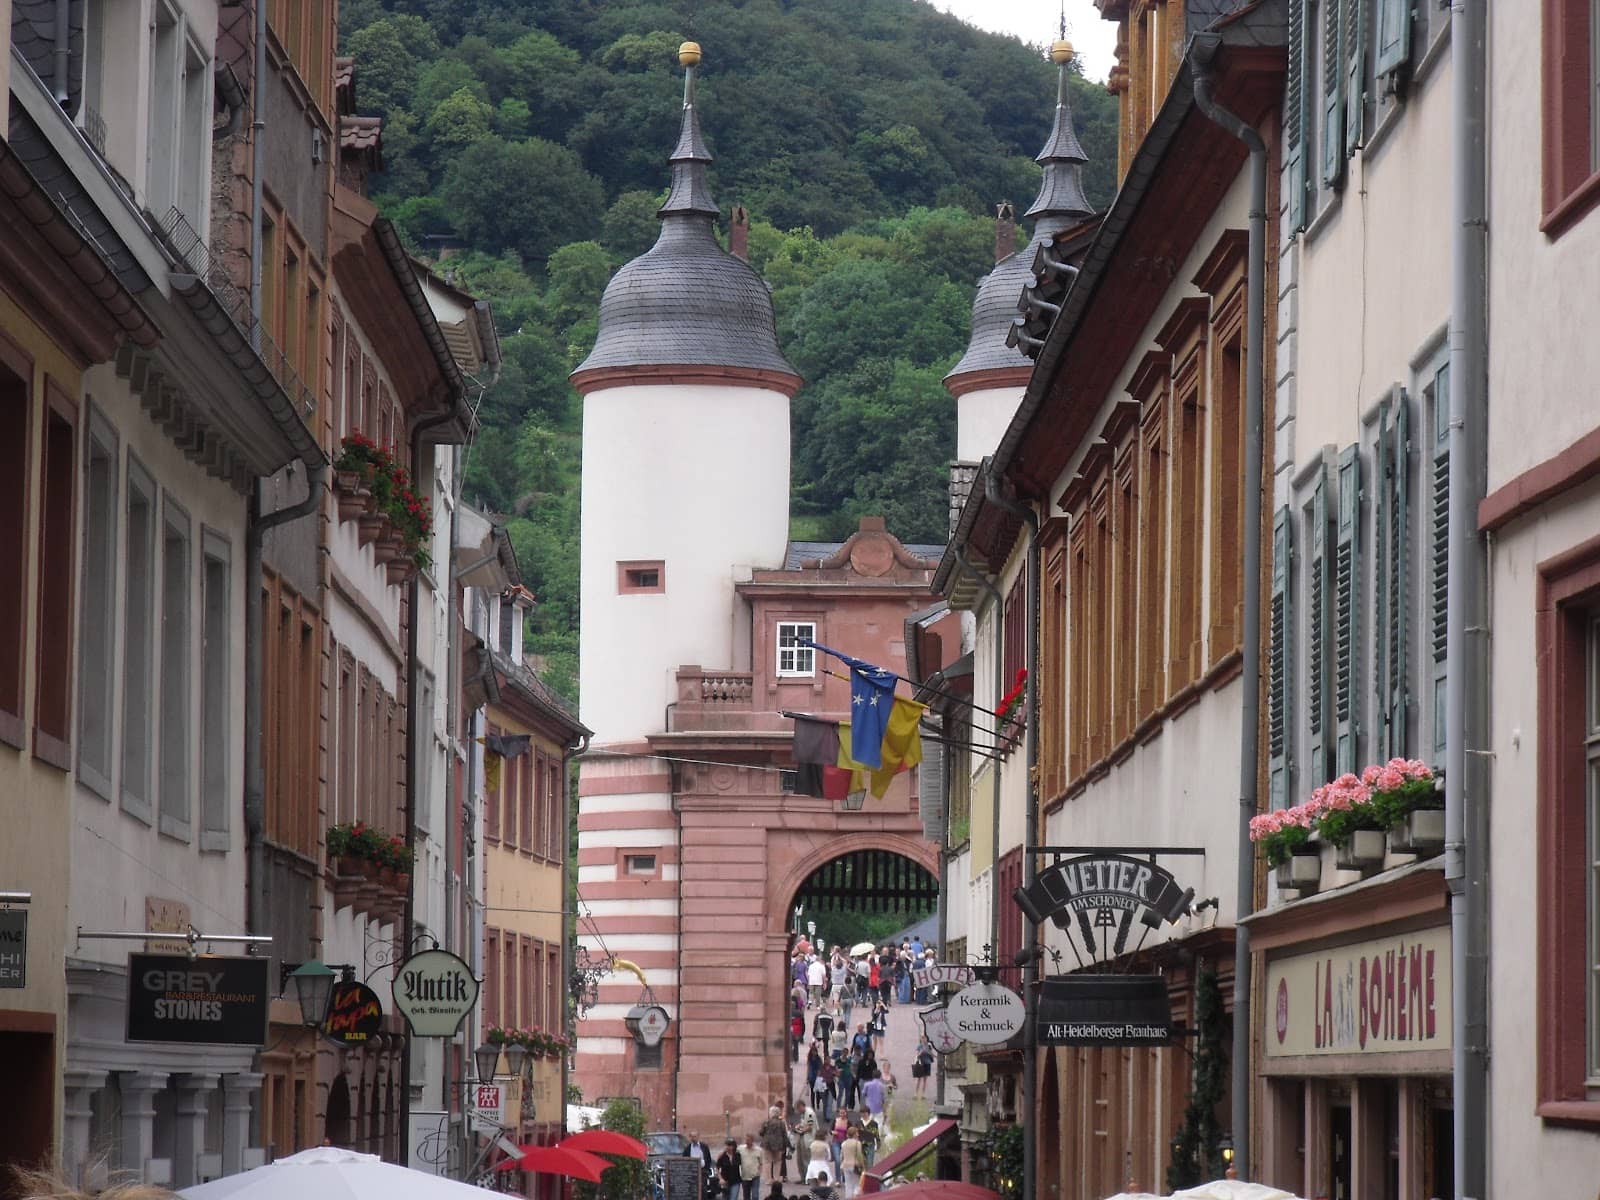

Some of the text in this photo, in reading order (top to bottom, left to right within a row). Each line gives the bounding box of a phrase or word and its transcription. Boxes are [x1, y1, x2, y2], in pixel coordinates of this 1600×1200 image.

[1058, 859, 1152, 899] VETTER
[143, 970, 224, 992] GREY
[404, 970, 469, 1002] Antik
[154, 999, 223, 1021] STONES
[960, 994, 1012, 1007] Keramik
[1315, 959, 1333, 1049] LA
[980, 1007, 991, 1020] &
[959, 1019, 1015, 1032] Schmuck
[1047, 1024, 1168, 1040] Alt-Heidelberger Brauhaus
[344, 1032, 368, 1040] BAR
